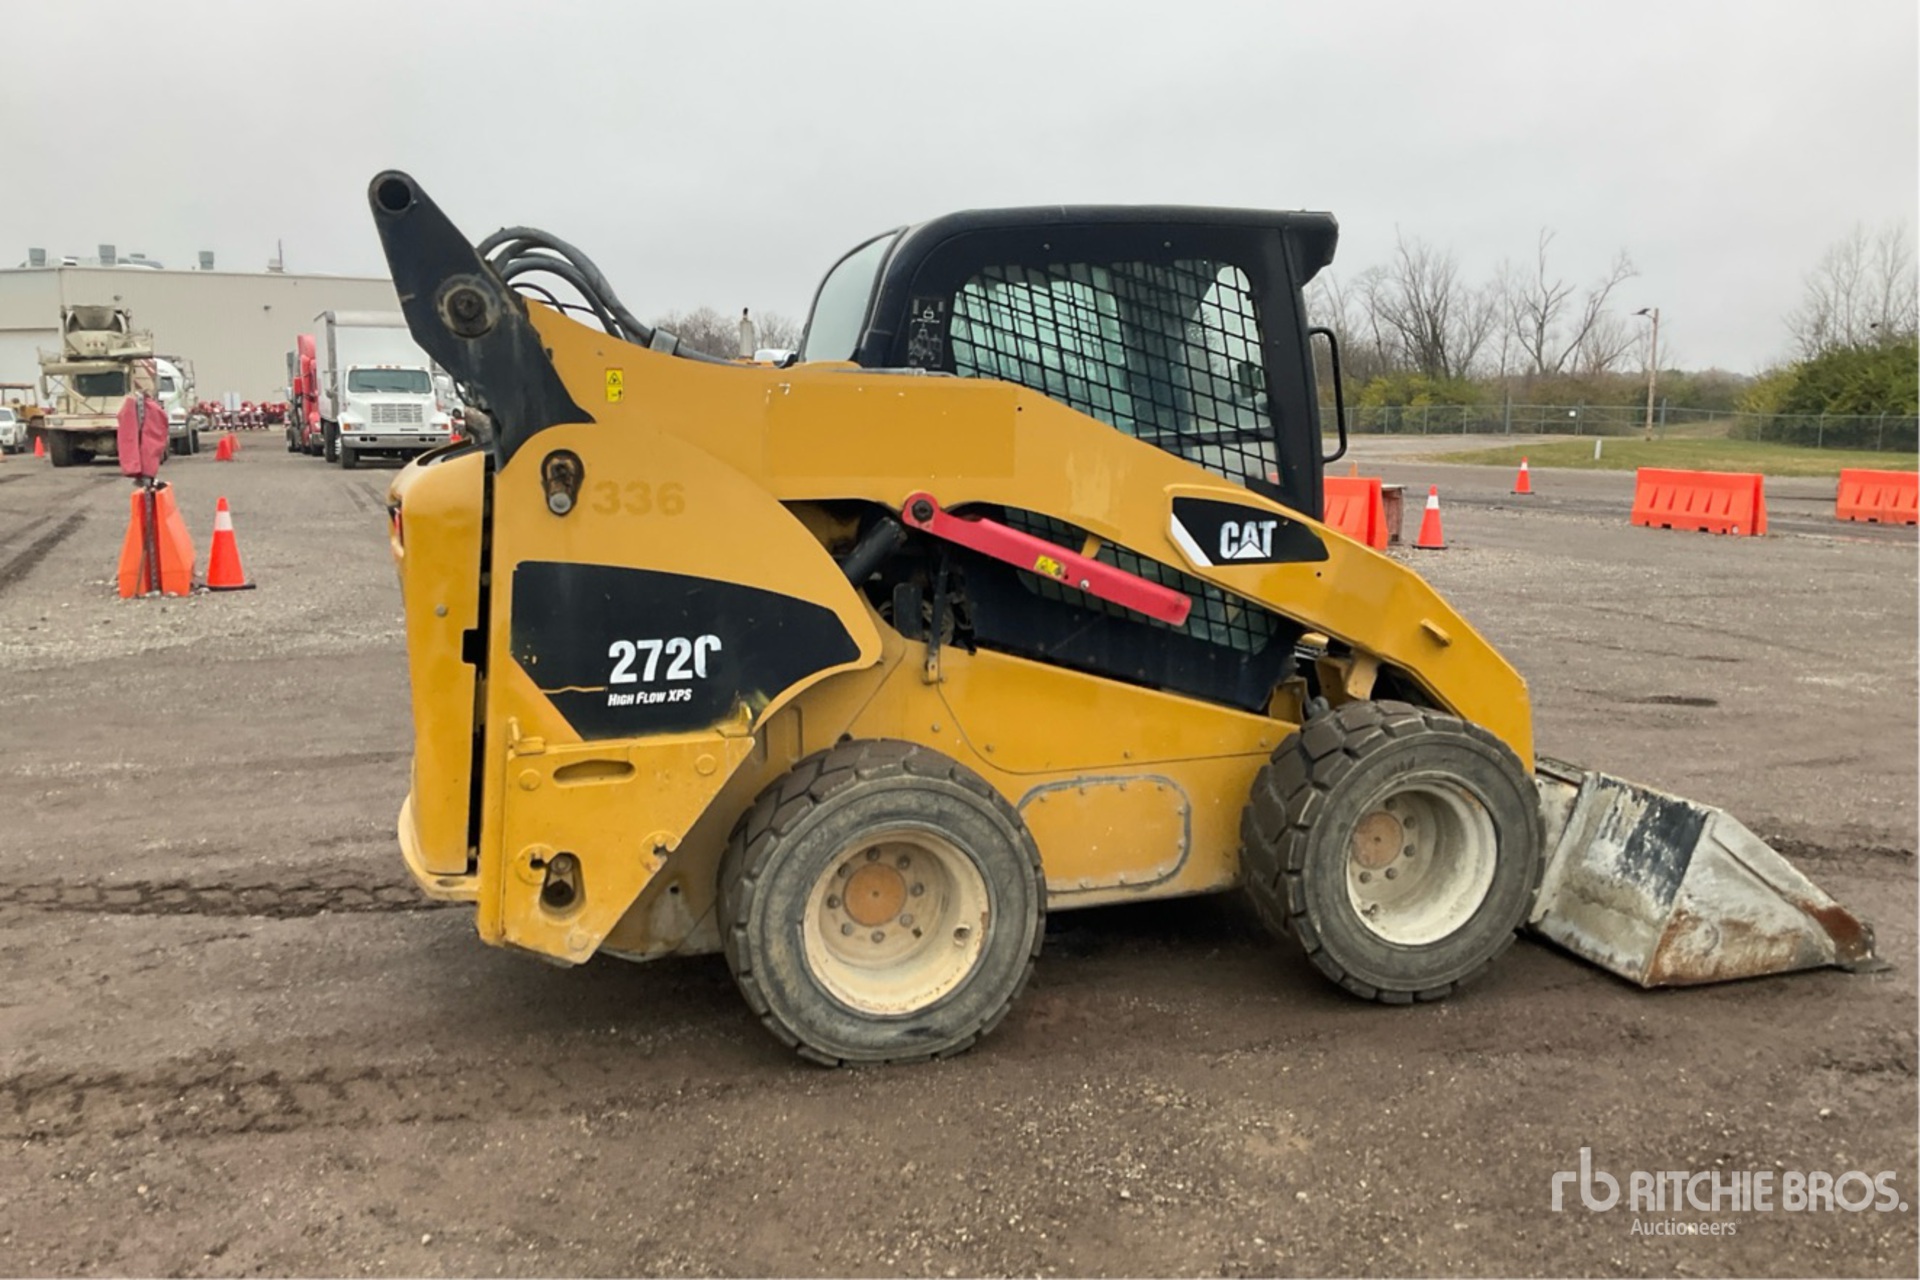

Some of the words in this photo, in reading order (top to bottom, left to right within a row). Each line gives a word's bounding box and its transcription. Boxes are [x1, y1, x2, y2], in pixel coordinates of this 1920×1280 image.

[592, 480, 686, 516] 336
[1219, 520, 1277, 560] CAT
[667, 688, 693, 702] XPS
